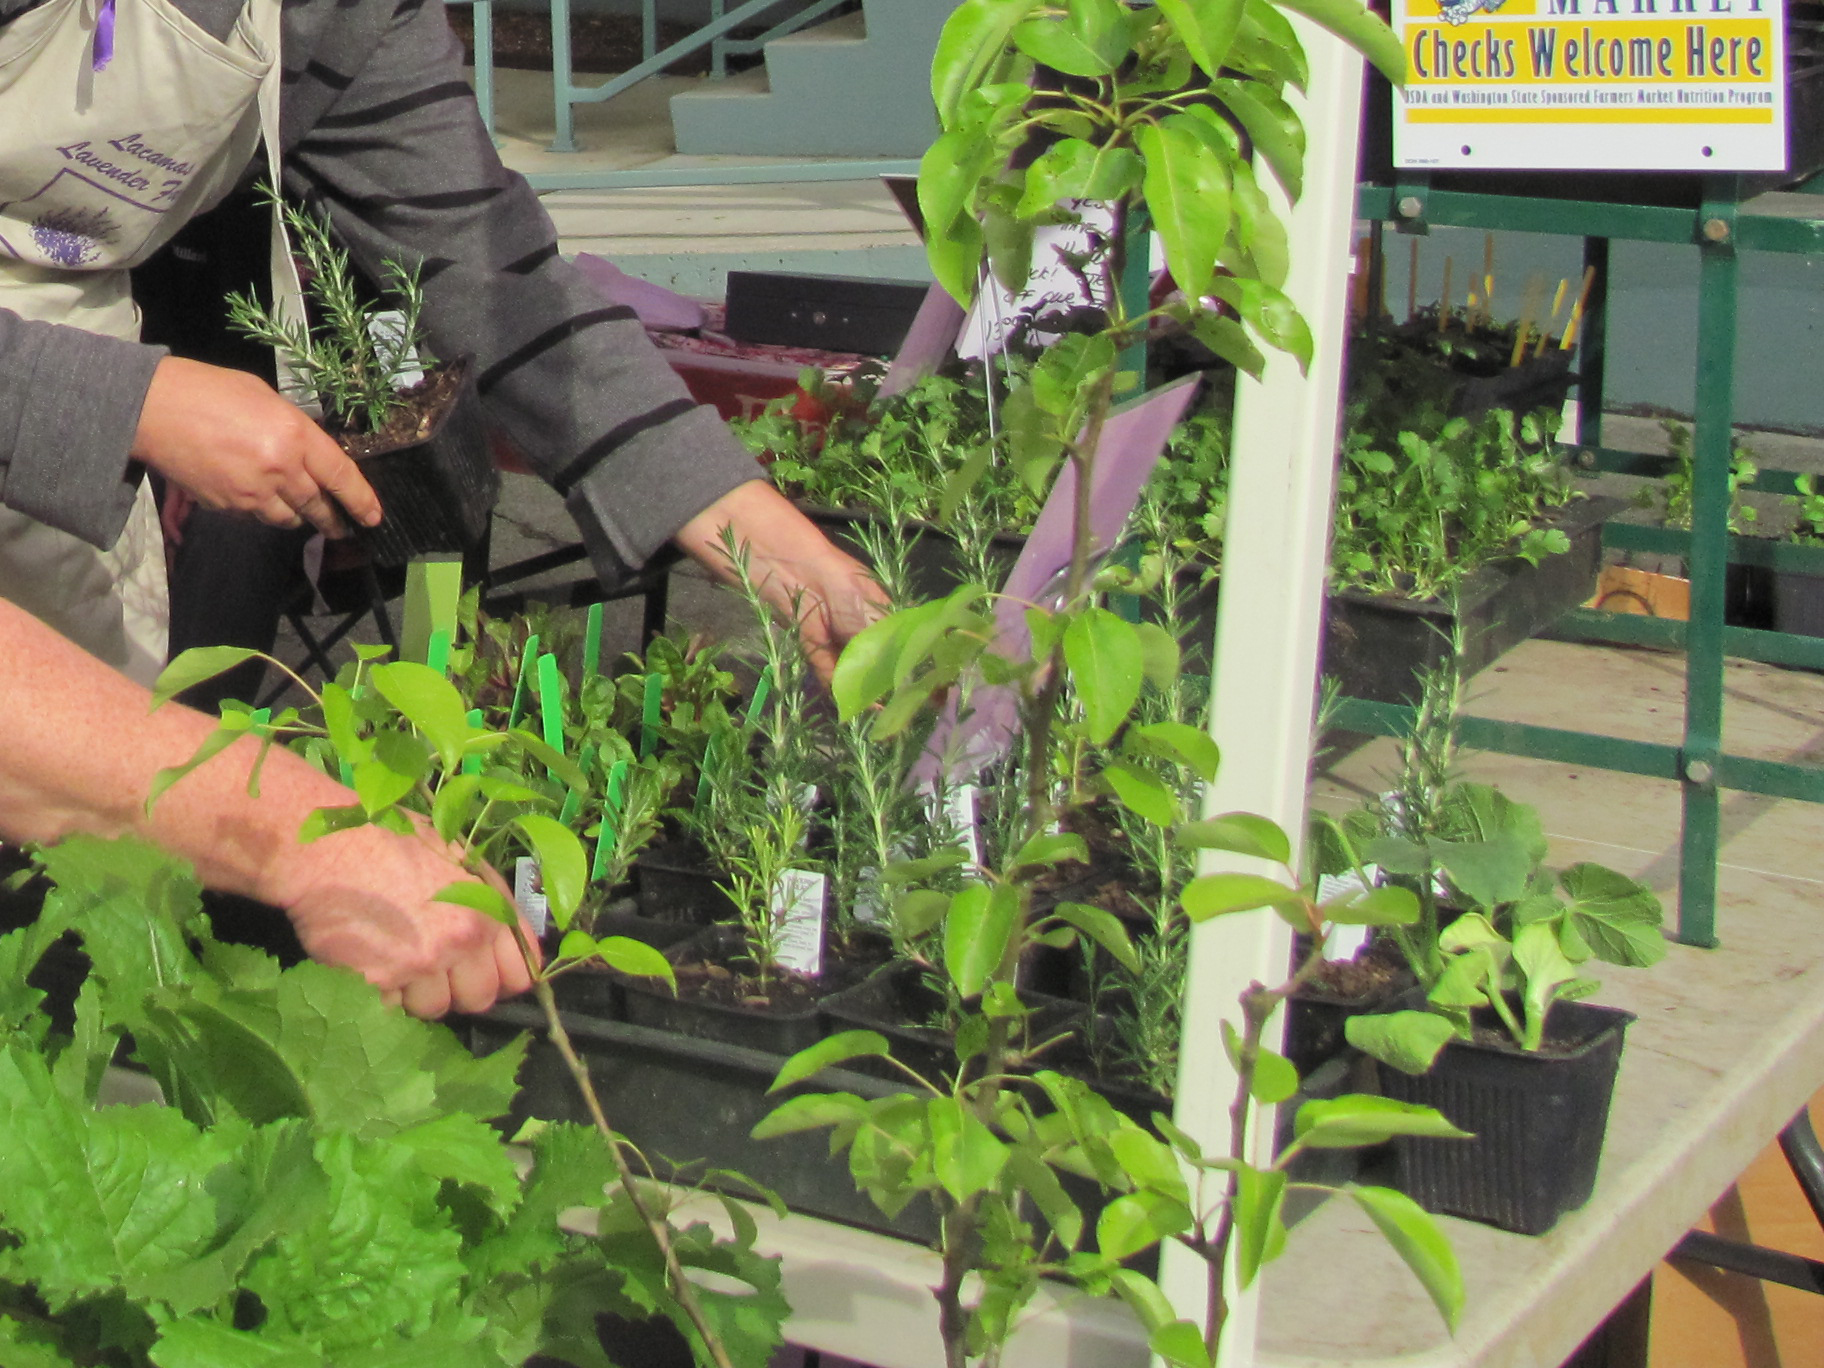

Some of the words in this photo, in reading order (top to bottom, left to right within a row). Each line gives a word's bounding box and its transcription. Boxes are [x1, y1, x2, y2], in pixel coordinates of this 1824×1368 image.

[1413, 28, 1516, 78] Checks
[1528, 27, 1672, 78] Welcome
[1686, 25, 1763, 78] Here
[1431, 90, 1448, 104] and
[1452, 90, 1508, 105] Washington
[1511, 89, 1537, 104] State
[1541, 89, 1590, 105] Sponsored
[1594, 89, 1633, 104] Farmers
[1637, 89, 1673, 103] Market
[1677, 89, 1724, 103] Nutrition
[1728, 89, 1773, 105] Program
[56, 141, 150, 191] Lavender
